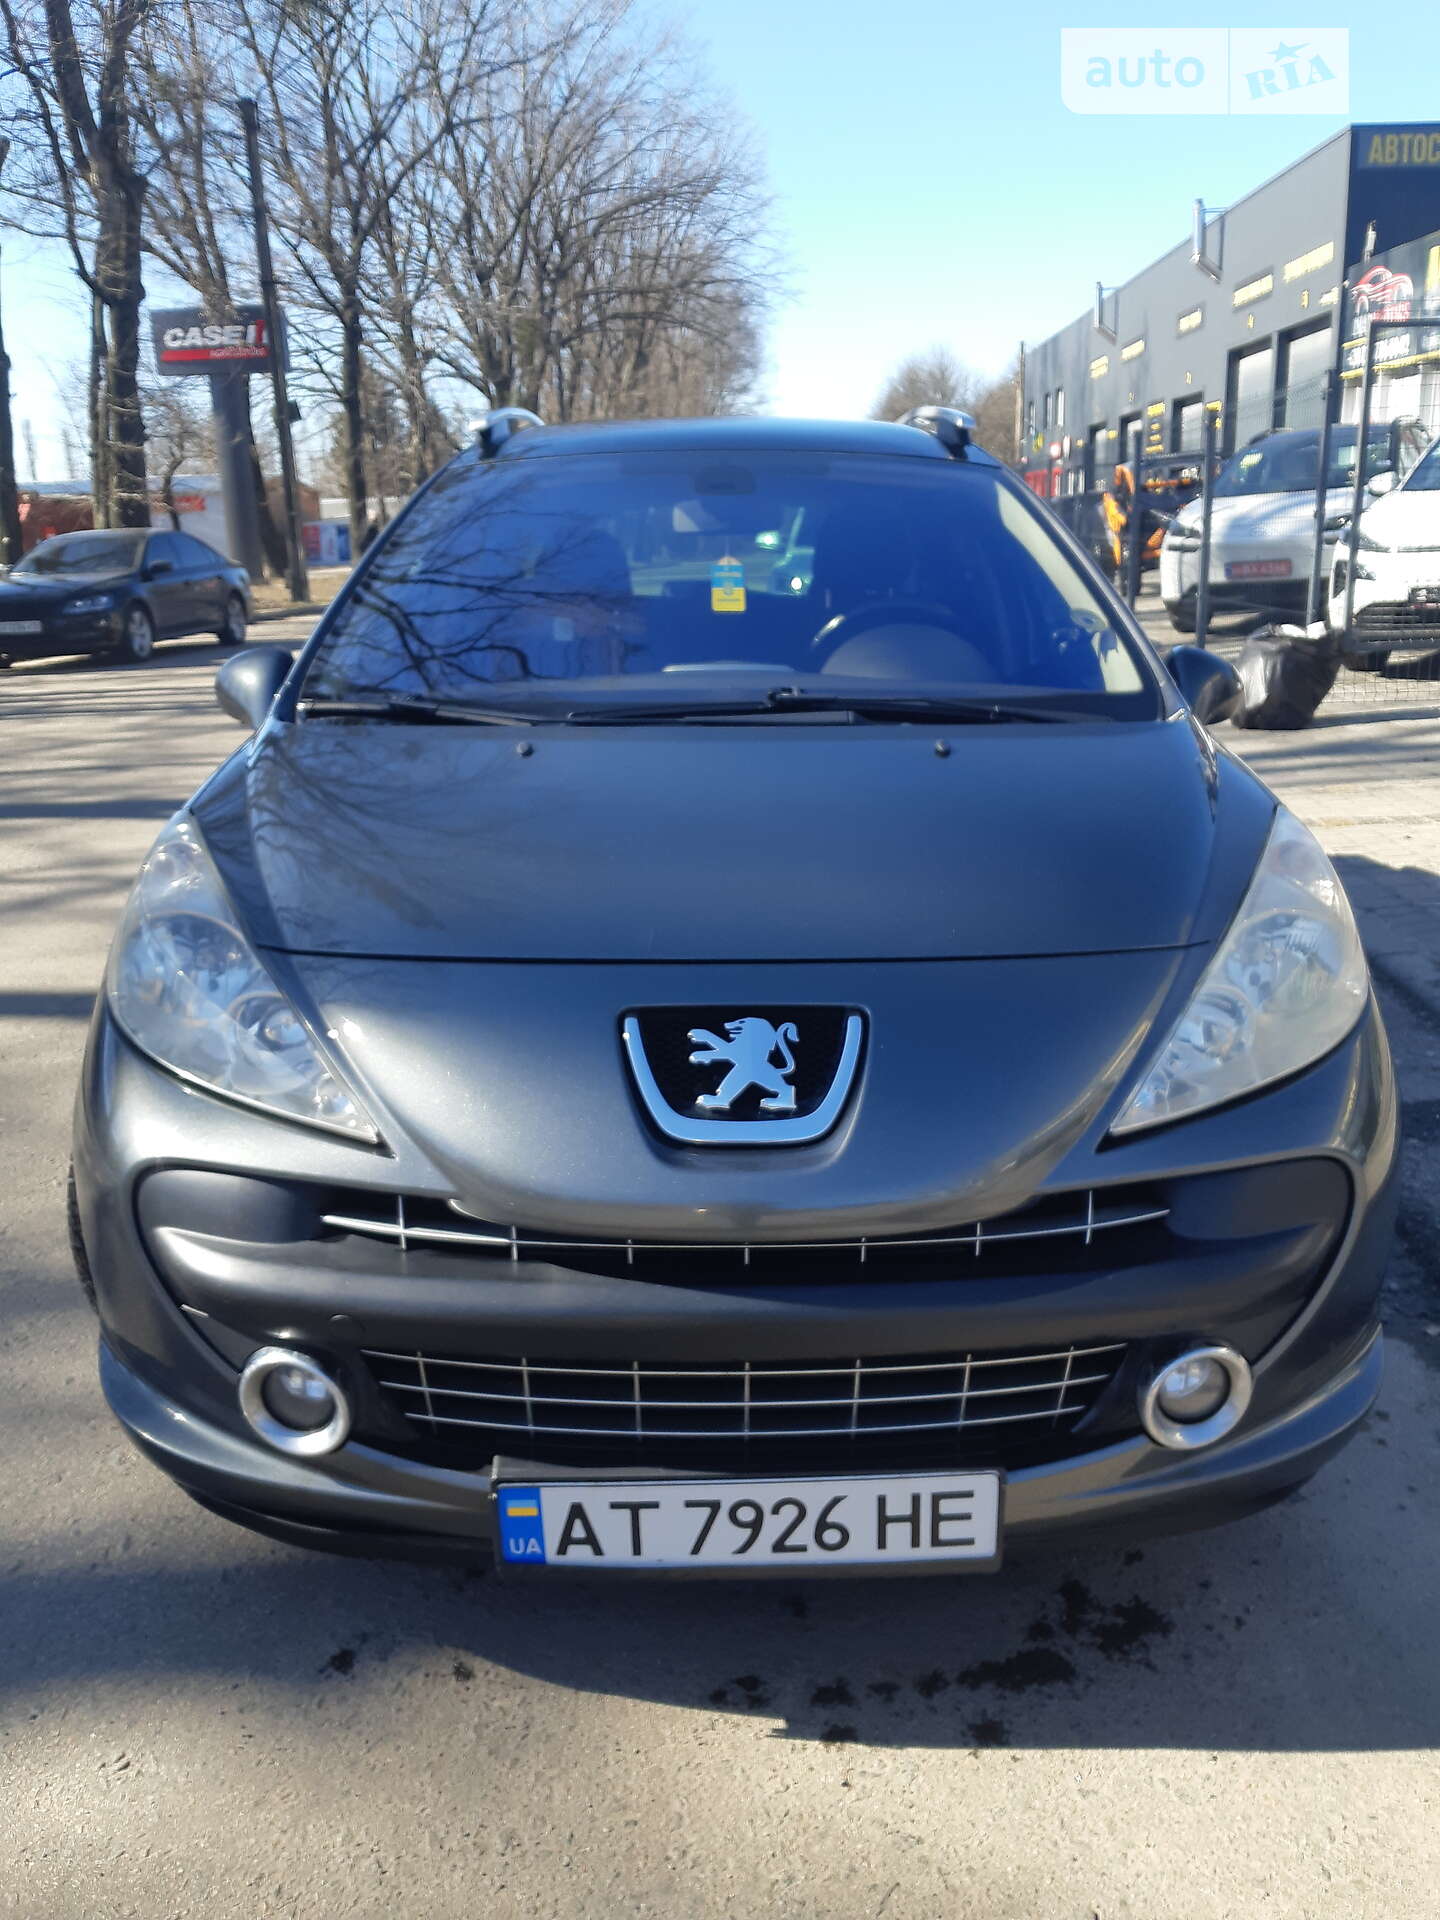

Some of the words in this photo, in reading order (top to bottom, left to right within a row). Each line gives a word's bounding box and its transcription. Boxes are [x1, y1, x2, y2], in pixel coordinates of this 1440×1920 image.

[163, 325, 246, 348] CASE
[556, 1502, 660, 1557] AT
[684, 1496, 850, 1556] 7926
[877, 1490, 975, 1550] HE
[509, 1537, 542, 1555] UA
